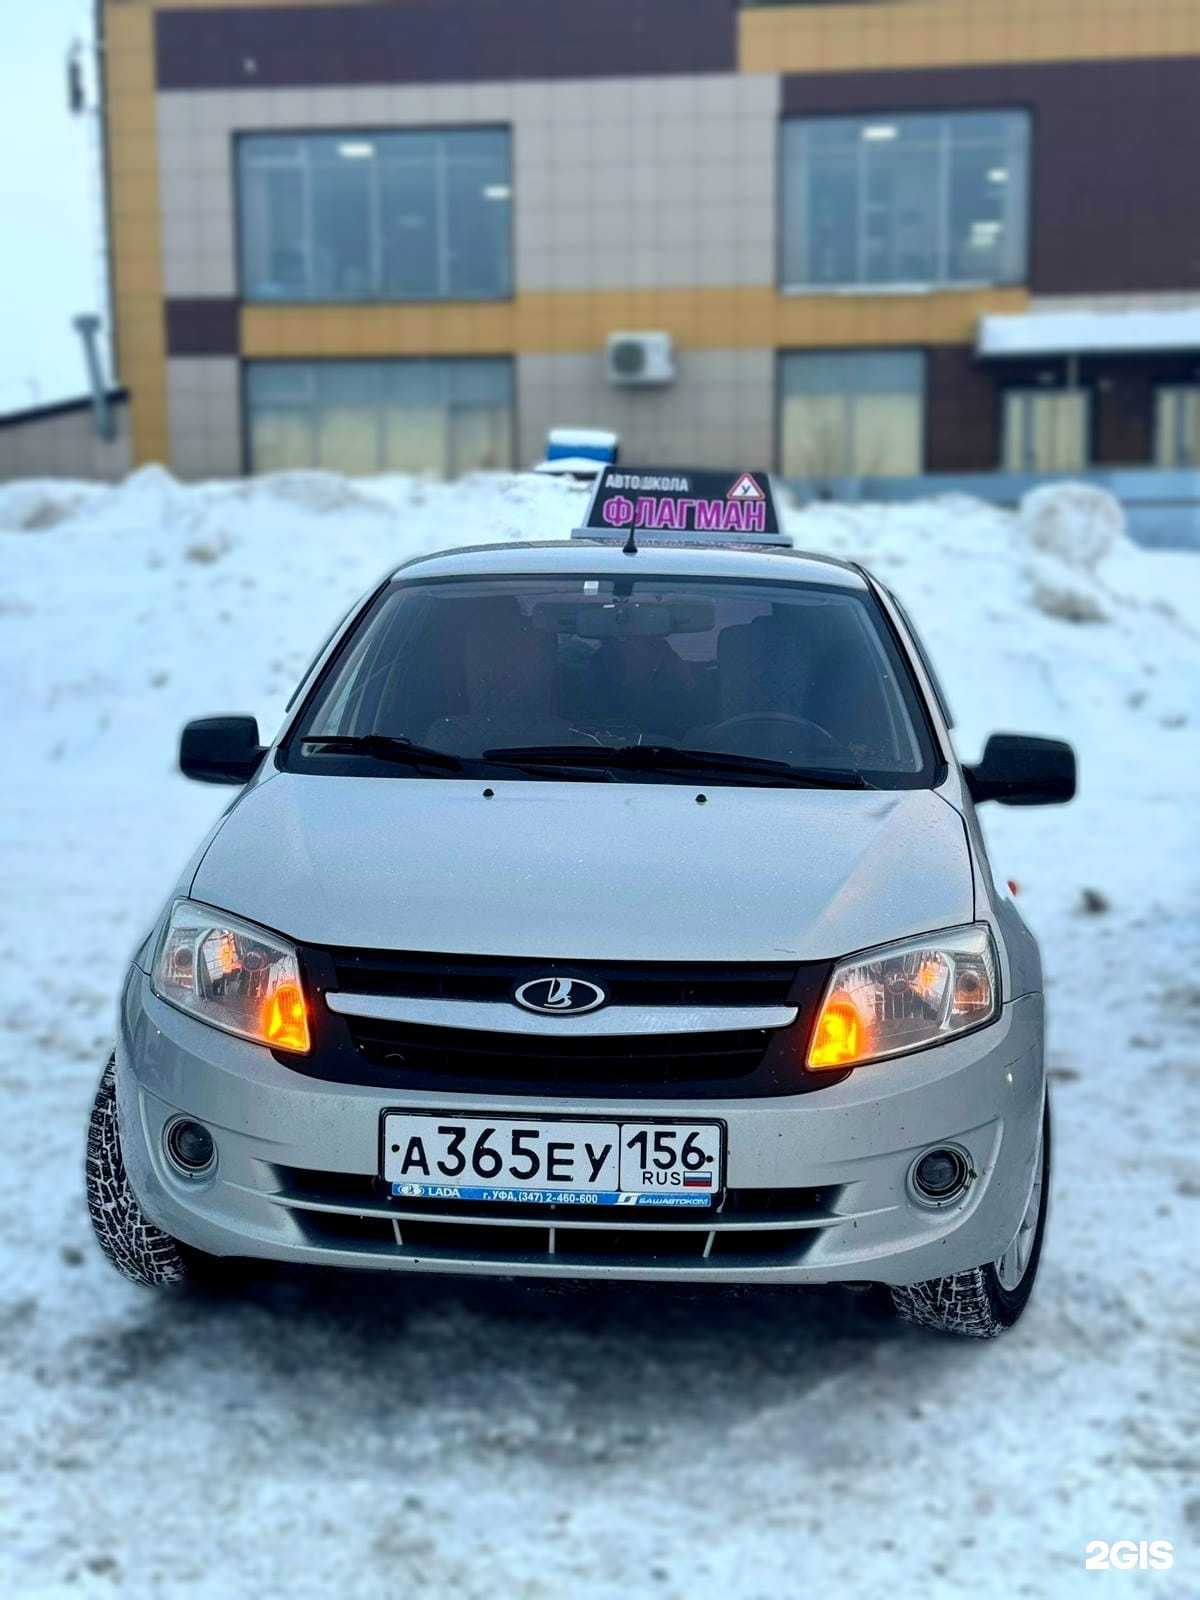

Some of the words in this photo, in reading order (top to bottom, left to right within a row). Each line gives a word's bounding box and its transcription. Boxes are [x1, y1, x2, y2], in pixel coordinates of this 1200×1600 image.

[605, 474, 689, 492] АВТОШКОЛА
[602, 495, 766, 532] ФЛАГМАН
[400, 1126, 613, 1183] А365ЕУ
[626, 1130, 706, 1171] 156
[642, 1170, 681, 1186] RUS
[428, 1187, 461, 1198] LADA
[518, 1191, 544, 1203] (347)
